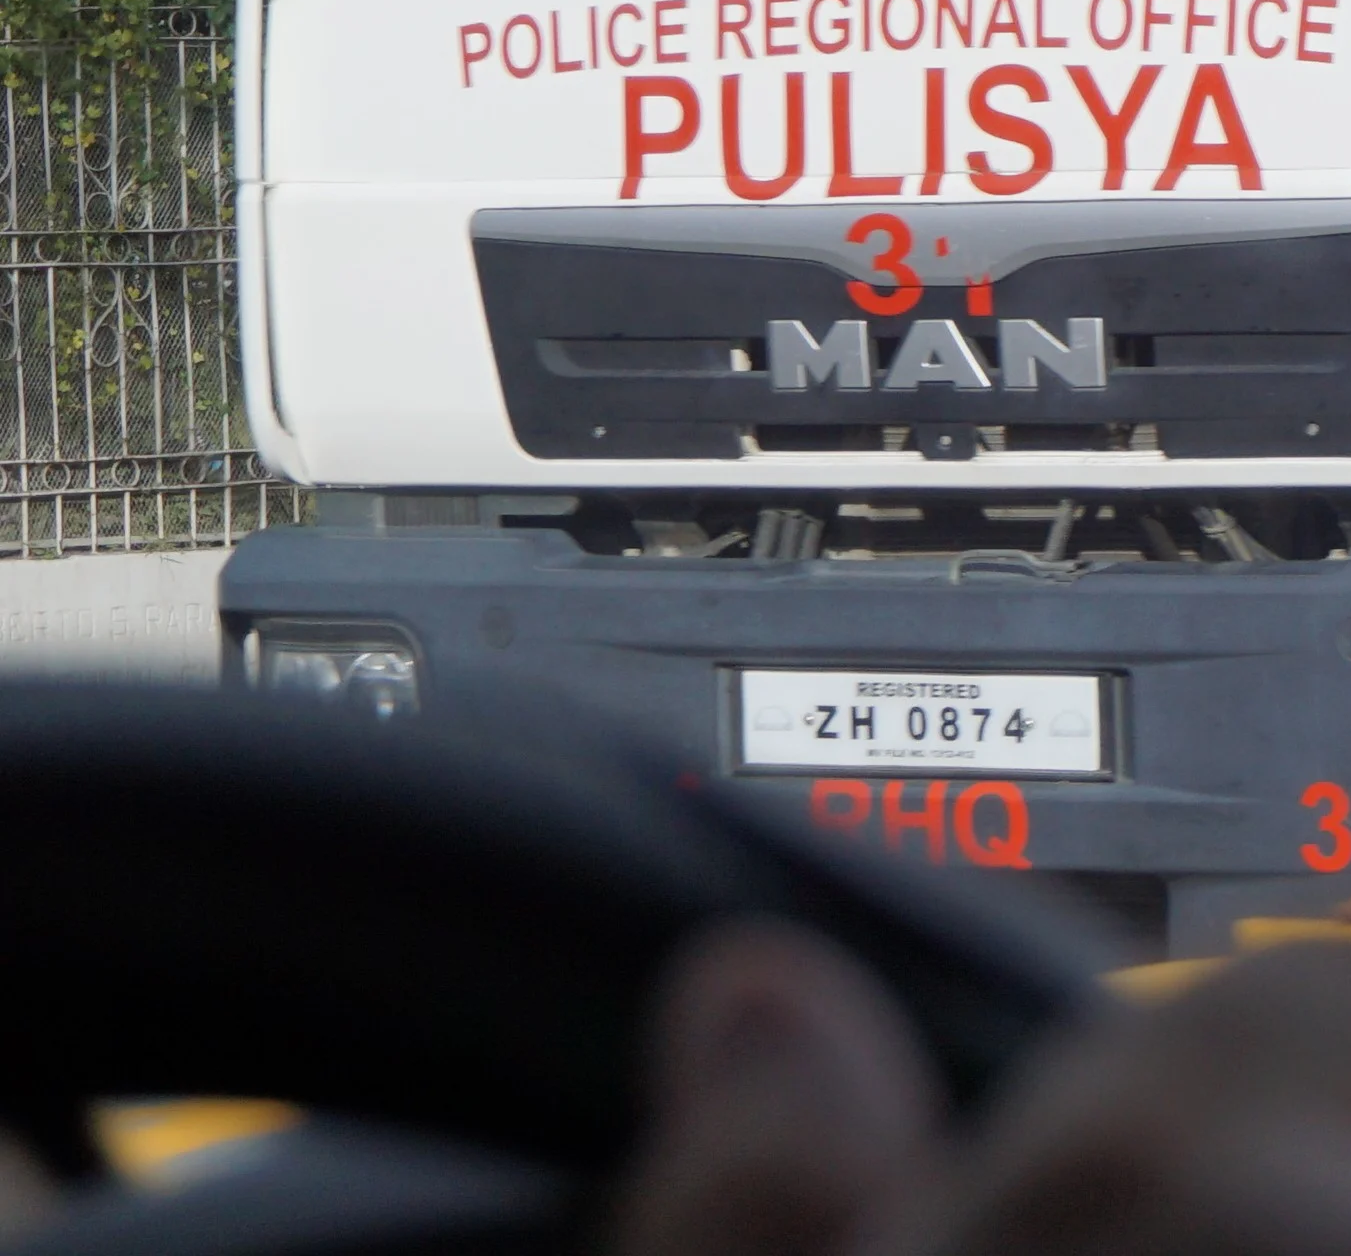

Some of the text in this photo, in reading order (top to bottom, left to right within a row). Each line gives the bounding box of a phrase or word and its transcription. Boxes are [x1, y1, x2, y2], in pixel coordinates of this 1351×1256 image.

[618, 63, 1266, 201] PULISYA
[767, 317, 1107, 391] MAN
[857, 682, 981, 699] REGISTERED
[815, 705, 1026, 743] ZH 0874
